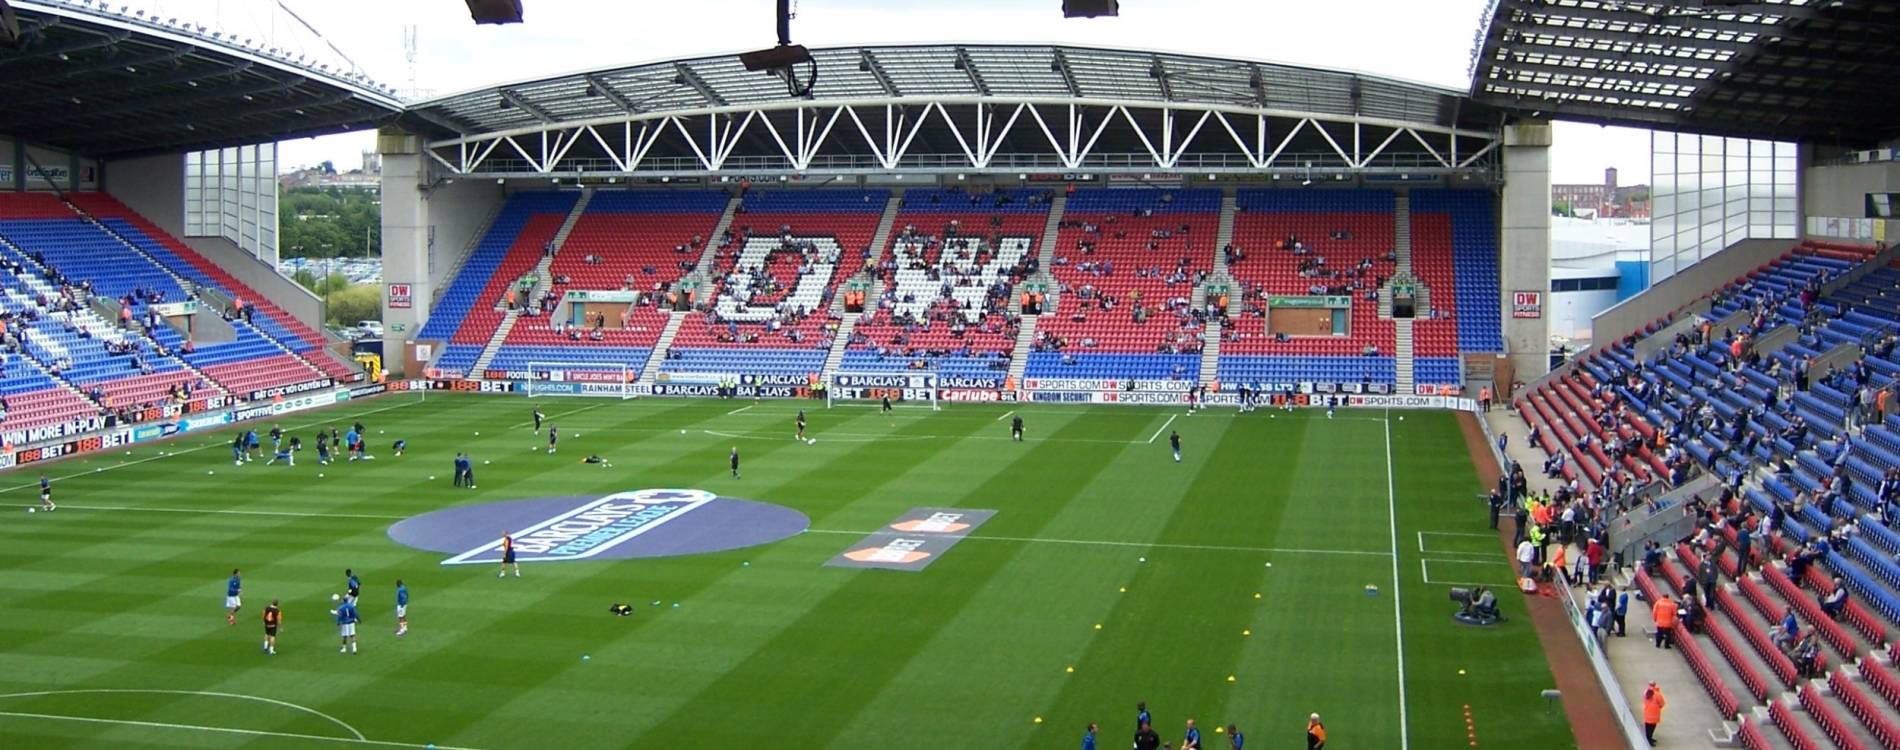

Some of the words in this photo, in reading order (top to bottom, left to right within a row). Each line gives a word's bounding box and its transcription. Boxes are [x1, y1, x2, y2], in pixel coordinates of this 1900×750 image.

[391, 286, 408, 296] DW
[1517, 293, 1537, 304] DW
[852, 376, 906, 387] BARCLAYS
[940, 378, 995, 388] BARCLAYS
[582, 384, 622, 393] RAINHAM
[624, 385, 650, 394] STEEL
[666, 386, 719, 395] BARCLAYS
[941, 389, 998, 401] Carlube
[1033, 393, 1060, 401] KINGDOM
[1062, 393, 1093, 402] SECURITY
[237, 405, 273, 421] SPORTFIVE
[2, 430, 26, 445] WIN
[29, 425, 62, 442] MORE
[64, 416, 106, 436] IN-PLAY
[495, 503, 645, 554] BARCLAYS
